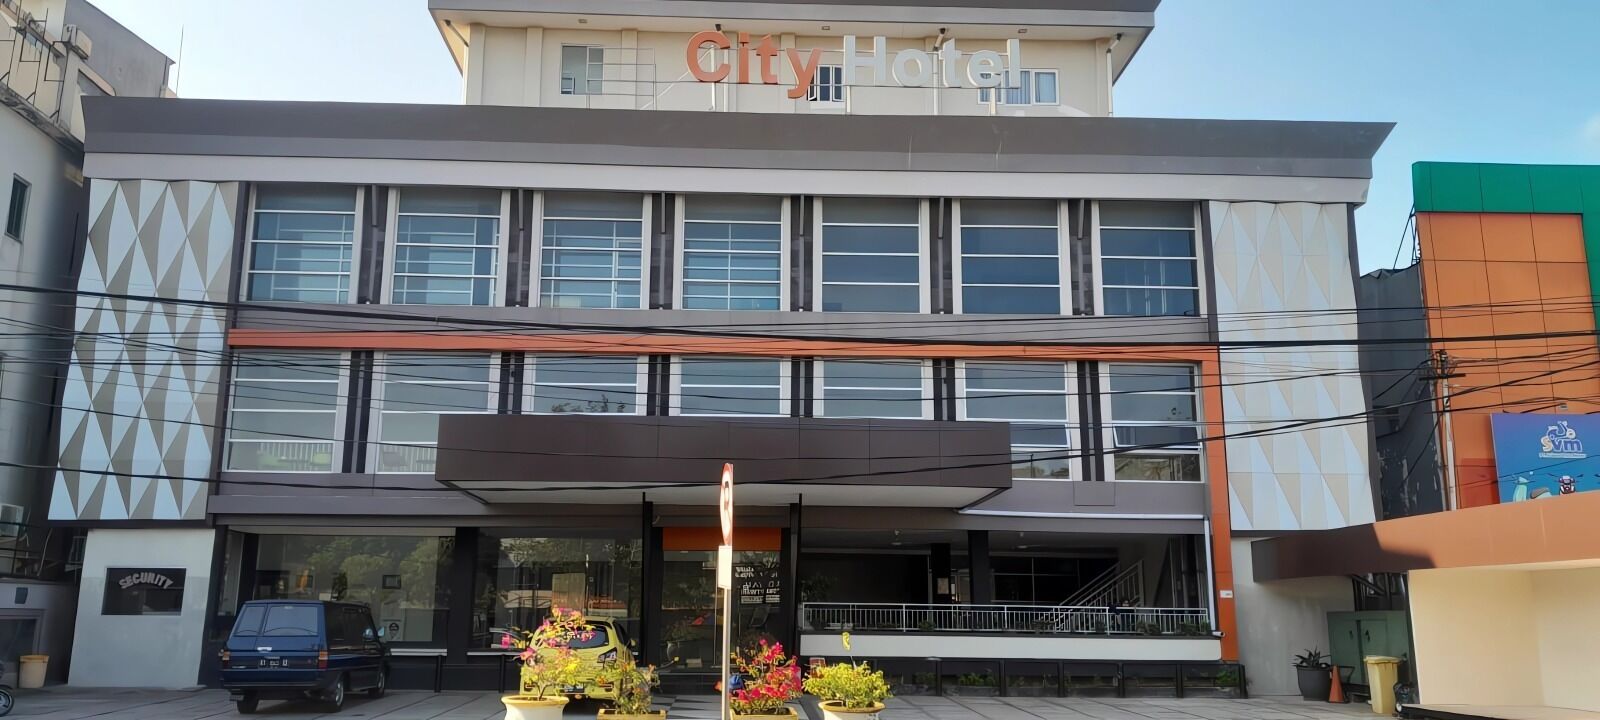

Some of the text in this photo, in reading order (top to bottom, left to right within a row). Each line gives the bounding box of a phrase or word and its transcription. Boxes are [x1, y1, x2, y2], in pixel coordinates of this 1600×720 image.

[686, 30, 1021, 99] City Hotel
[119, 572, 174, 589] SECURITY
